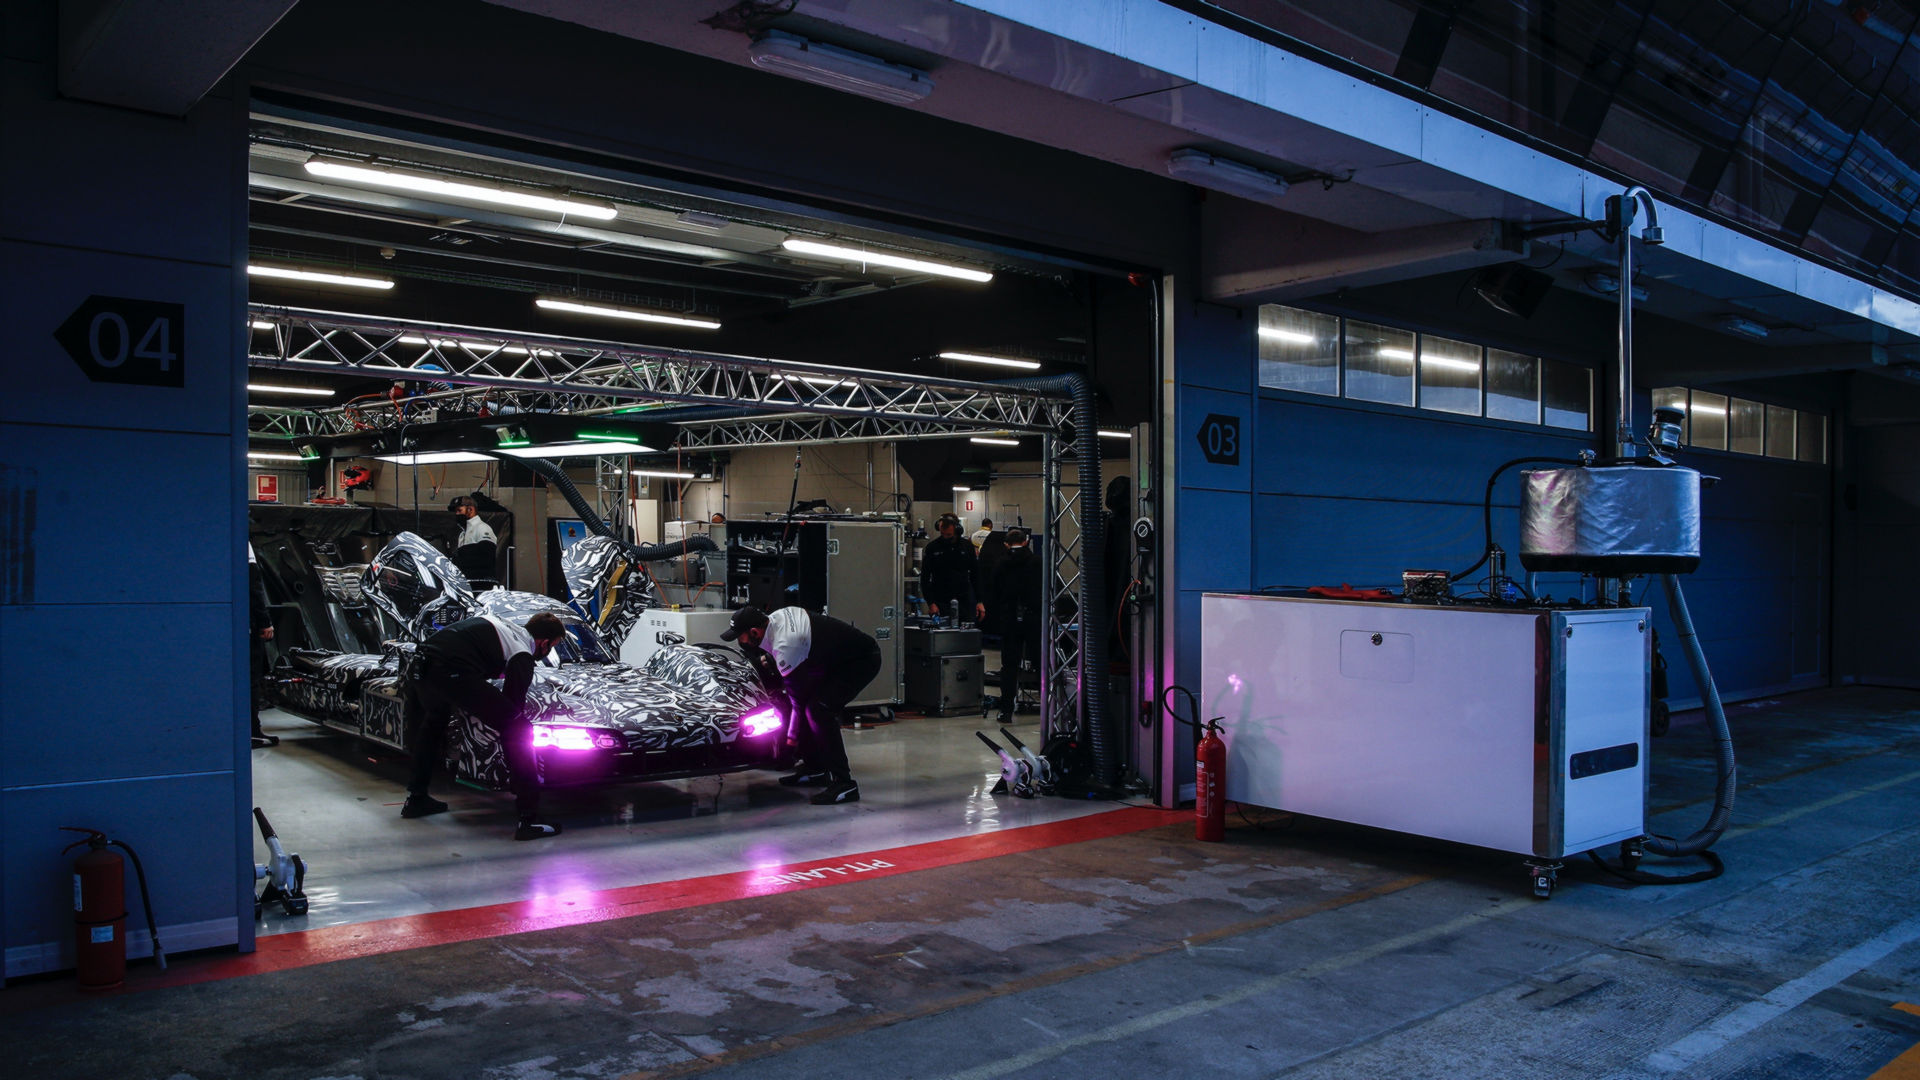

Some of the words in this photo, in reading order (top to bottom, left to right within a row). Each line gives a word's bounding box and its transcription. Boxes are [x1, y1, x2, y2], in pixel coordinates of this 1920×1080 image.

[89, 311, 177, 371] 04
[1207, 422, 1236, 456] 03
[760, 859, 896, 885] PIT-LANE
